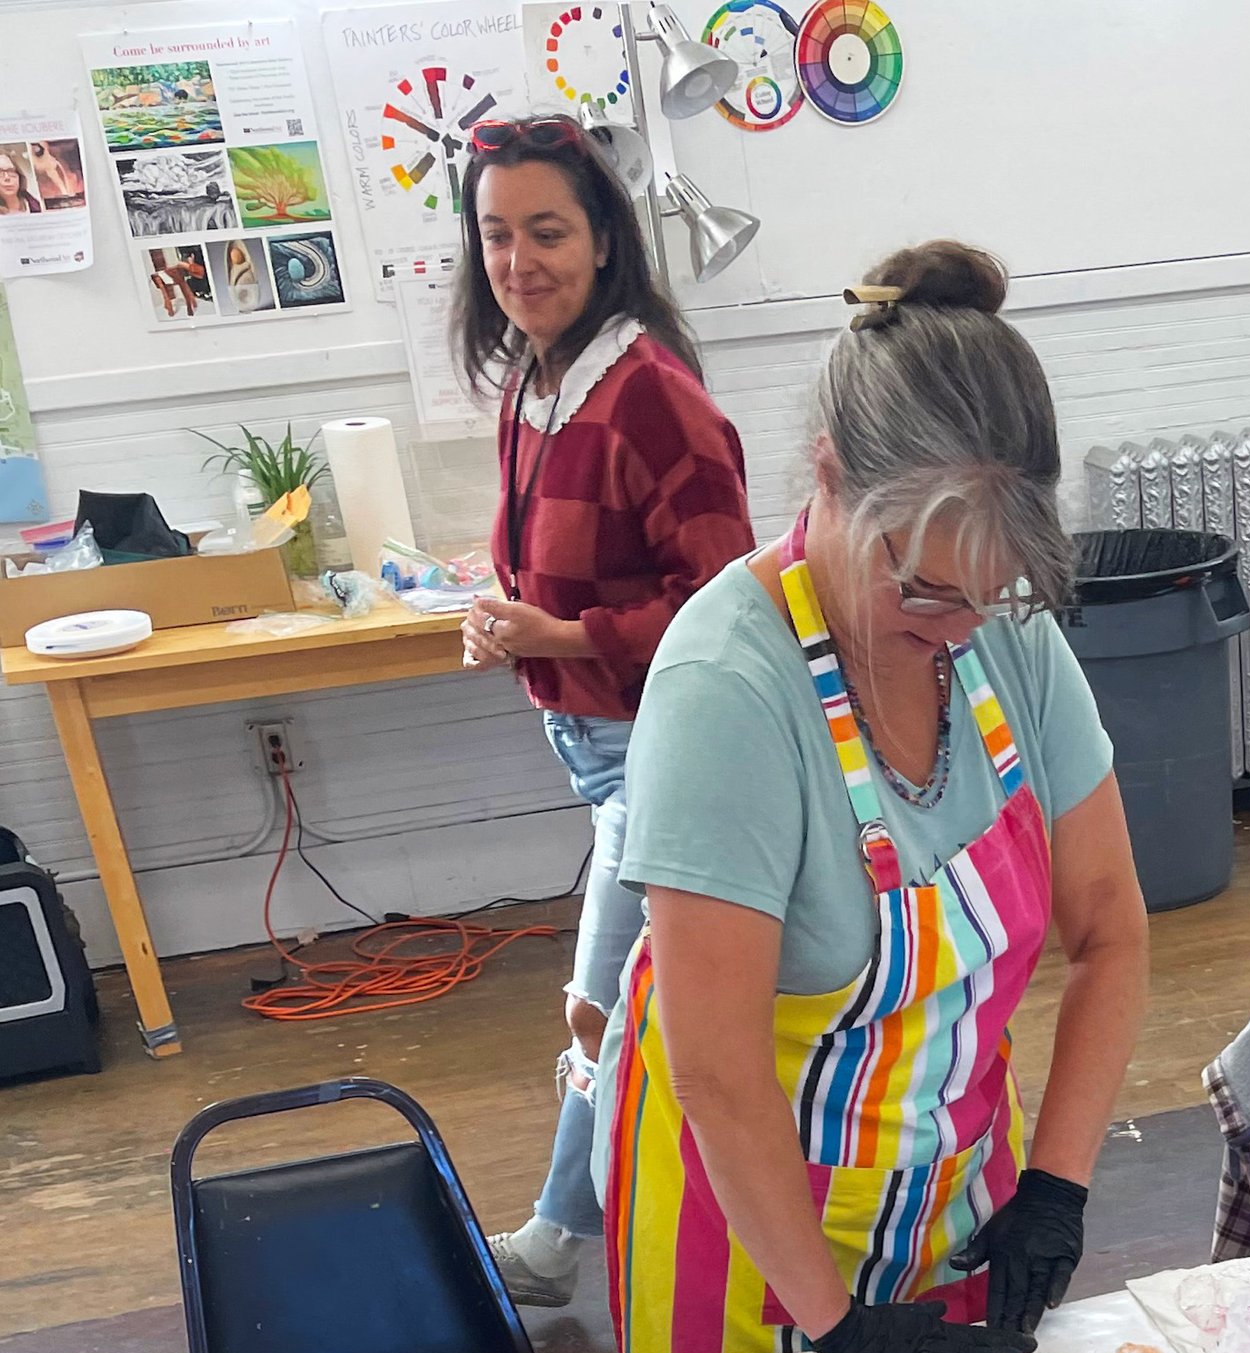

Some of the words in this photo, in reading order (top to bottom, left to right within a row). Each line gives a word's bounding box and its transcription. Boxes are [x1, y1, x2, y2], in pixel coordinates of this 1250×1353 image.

[430, 18, 477, 41] COLOR
[477, 14, 523, 36] WHEEL
[113, 44, 147, 58] Come
[149, 43, 164, 55] be
[167, 37, 235, 54] surrounded
[237, 37, 251, 52] by
[253, 36, 271, 47] art
[345, 108, 366, 163] COLORS
[355, 166, 377, 212] WARM
